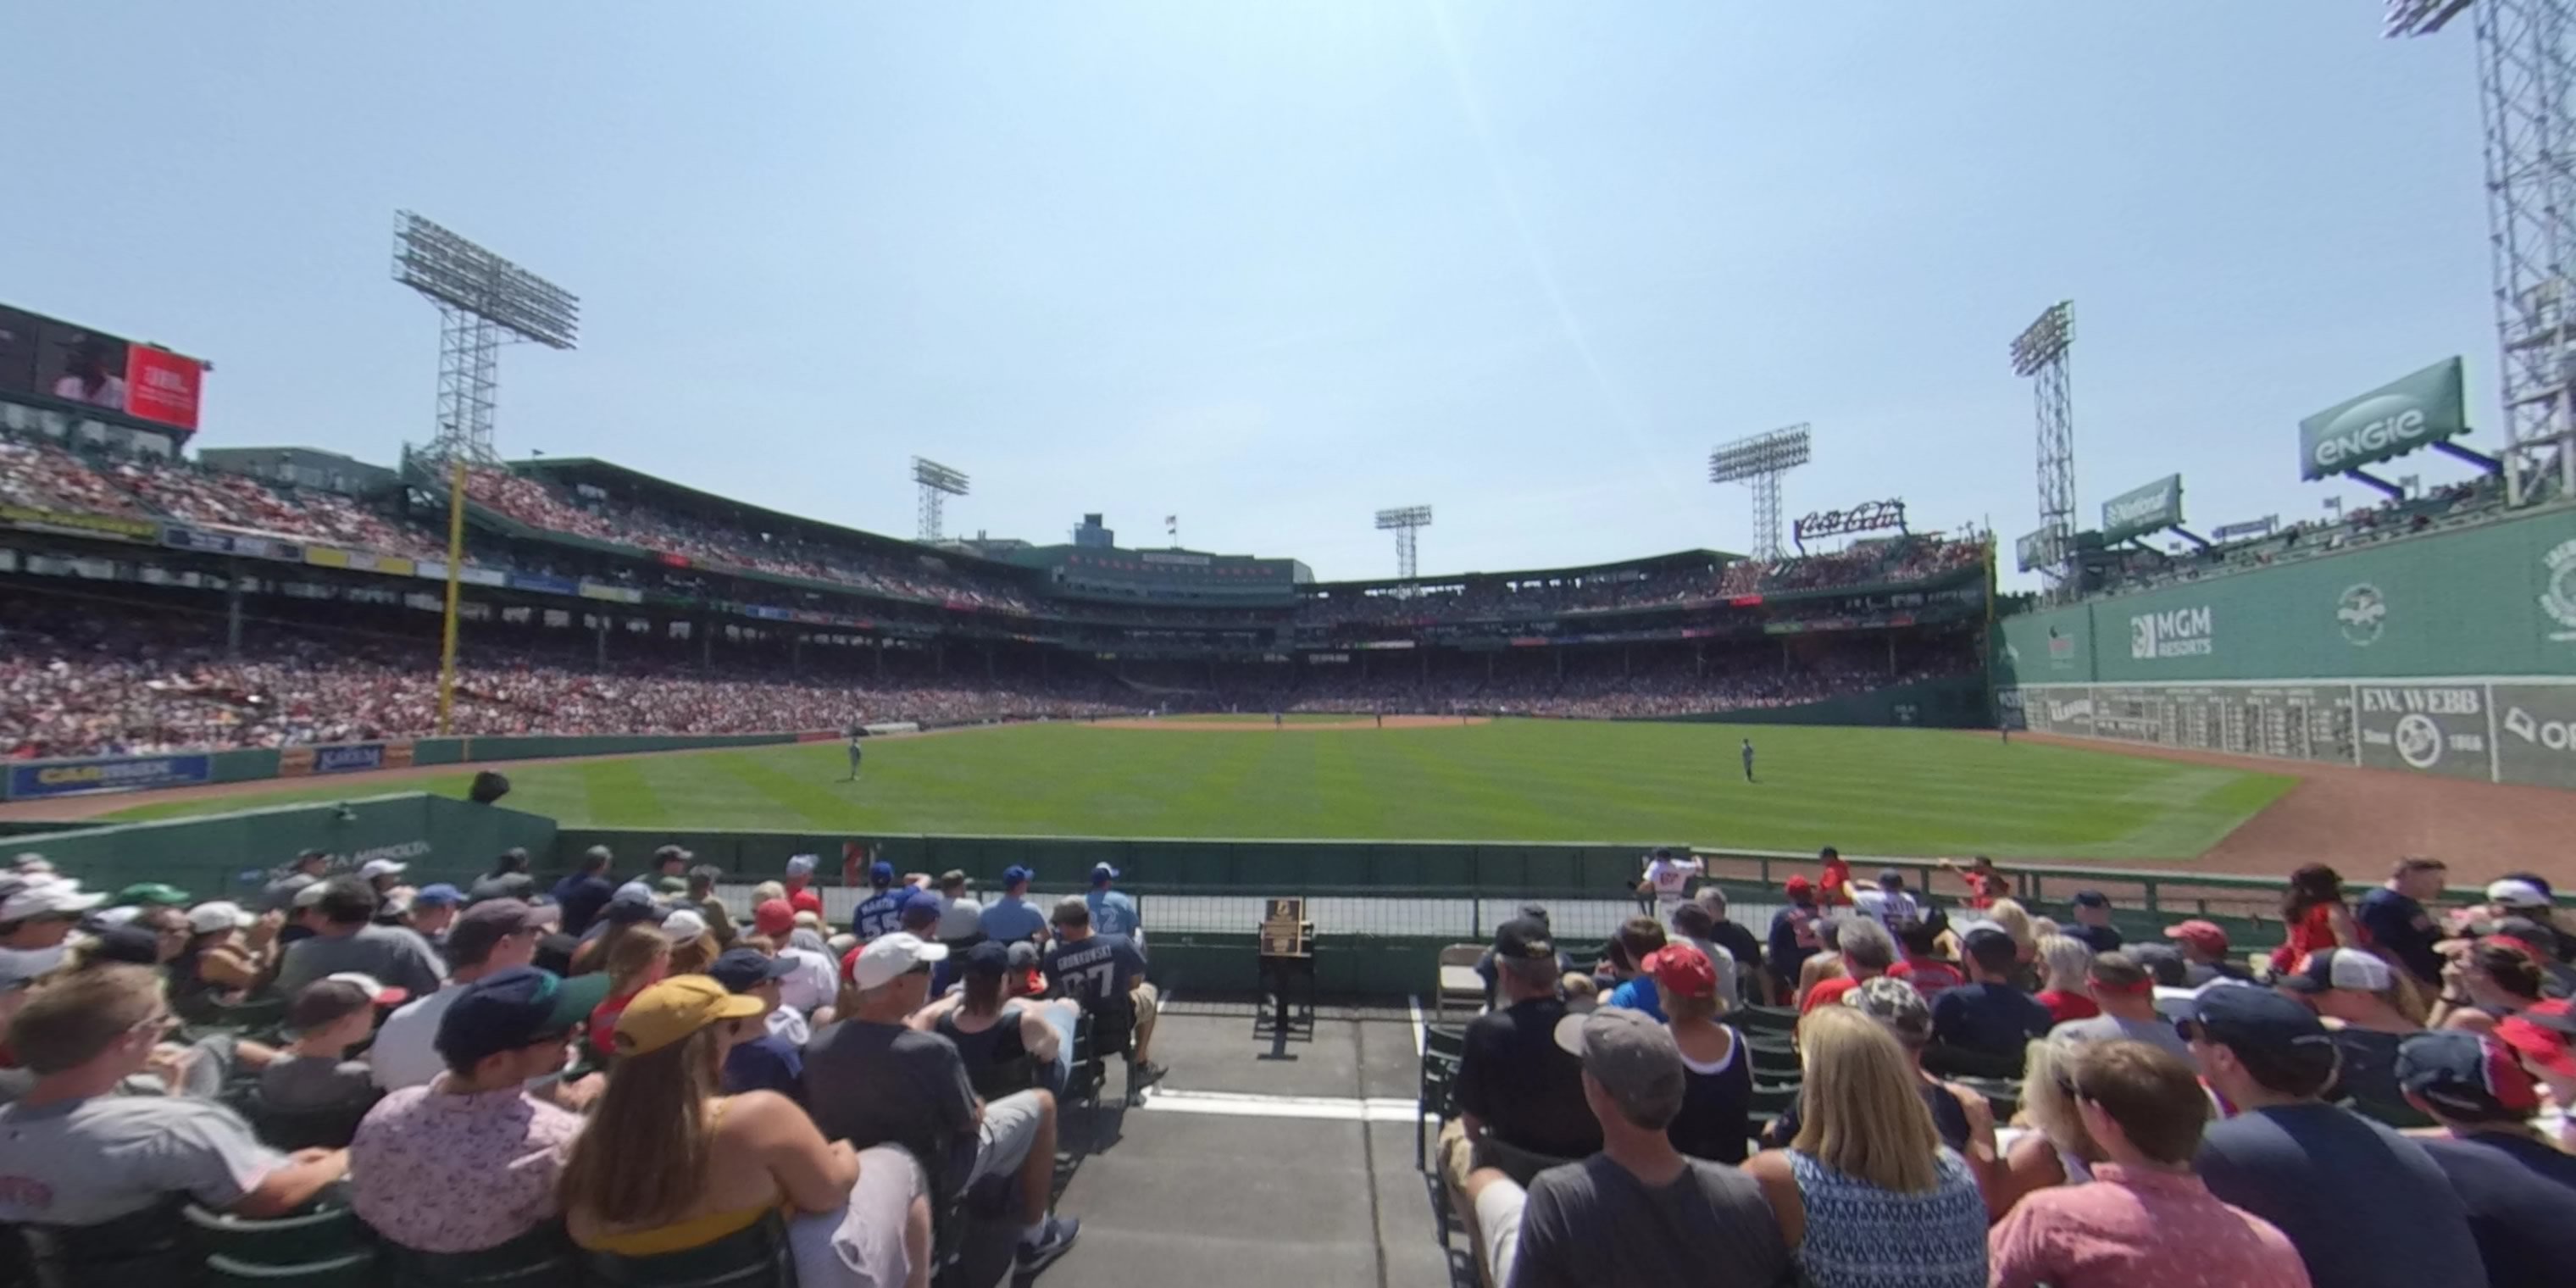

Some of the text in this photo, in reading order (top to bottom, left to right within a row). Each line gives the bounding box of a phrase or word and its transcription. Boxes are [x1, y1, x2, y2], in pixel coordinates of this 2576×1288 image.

[1800, 500, 1903, 536] Coca-Cola
[2157, 605, 2211, 639] MGM
[2158, 637, 2212, 657] RESORTS
[2401, 688, 2479, 714] WEBB
[862, 910, 902, 941] 55
[1057, 944, 1113, 972] GRONKOWSKI
